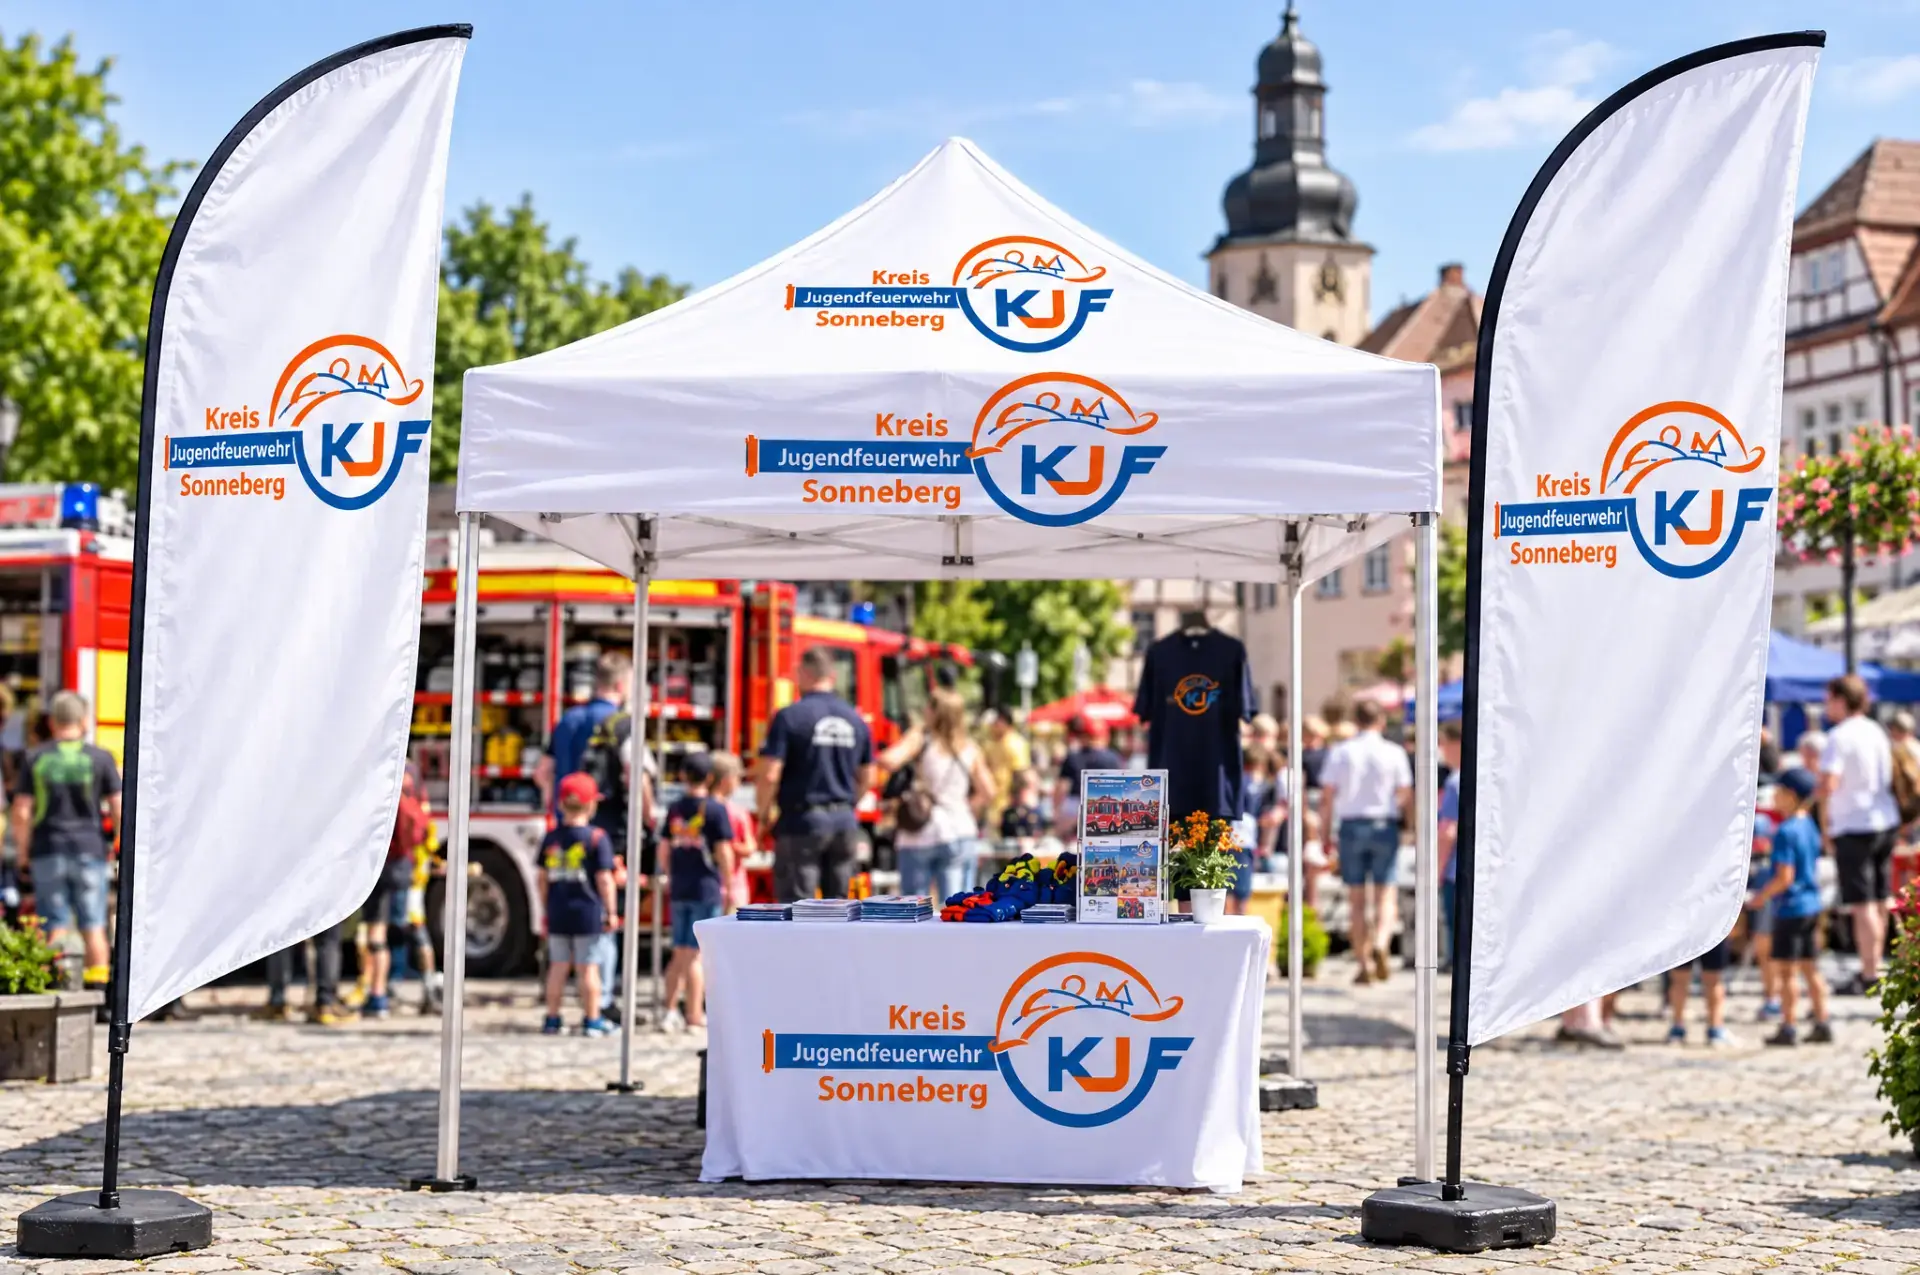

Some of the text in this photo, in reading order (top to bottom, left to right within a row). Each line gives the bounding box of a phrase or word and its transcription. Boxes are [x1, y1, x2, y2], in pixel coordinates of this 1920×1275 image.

[872, 269, 930, 285] Kreis
[803, 290, 950, 307] Jugendfeuerwehr
[995, 288, 1114, 328] KJF
[815, 310, 945, 331] Sonneberg
[205, 405, 260, 430] Kreis
[875, 412, 948, 437] Kreis
[171, 440, 291, 465] Jugendfeuerwehr
[321, 420, 431, 477] KJF
[777, 448, 960, 471] Jugendfeuerwehr
[1021, 445, 1168, 496] KJF
[180, 472, 285, 500] Sonneberg
[802, 479, 961, 509] Sonneberg
[1536, 471, 1591, 497] Kreis
[1501, 506, 1622, 533] Jugendfeuerwehr
[1654, 487, 1773, 546] KJF
[1510, 540, 1617, 569] Sonneberg
[1185, 689, 1222, 709] KJF
[888, 1004, 966, 1030] Kreis
[791, 1041, 983, 1067] Jugendfeuerwehr
[1048, 1036, 1195, 1093] KJF
[817, 1075, 988, 1109] Sonneberg
